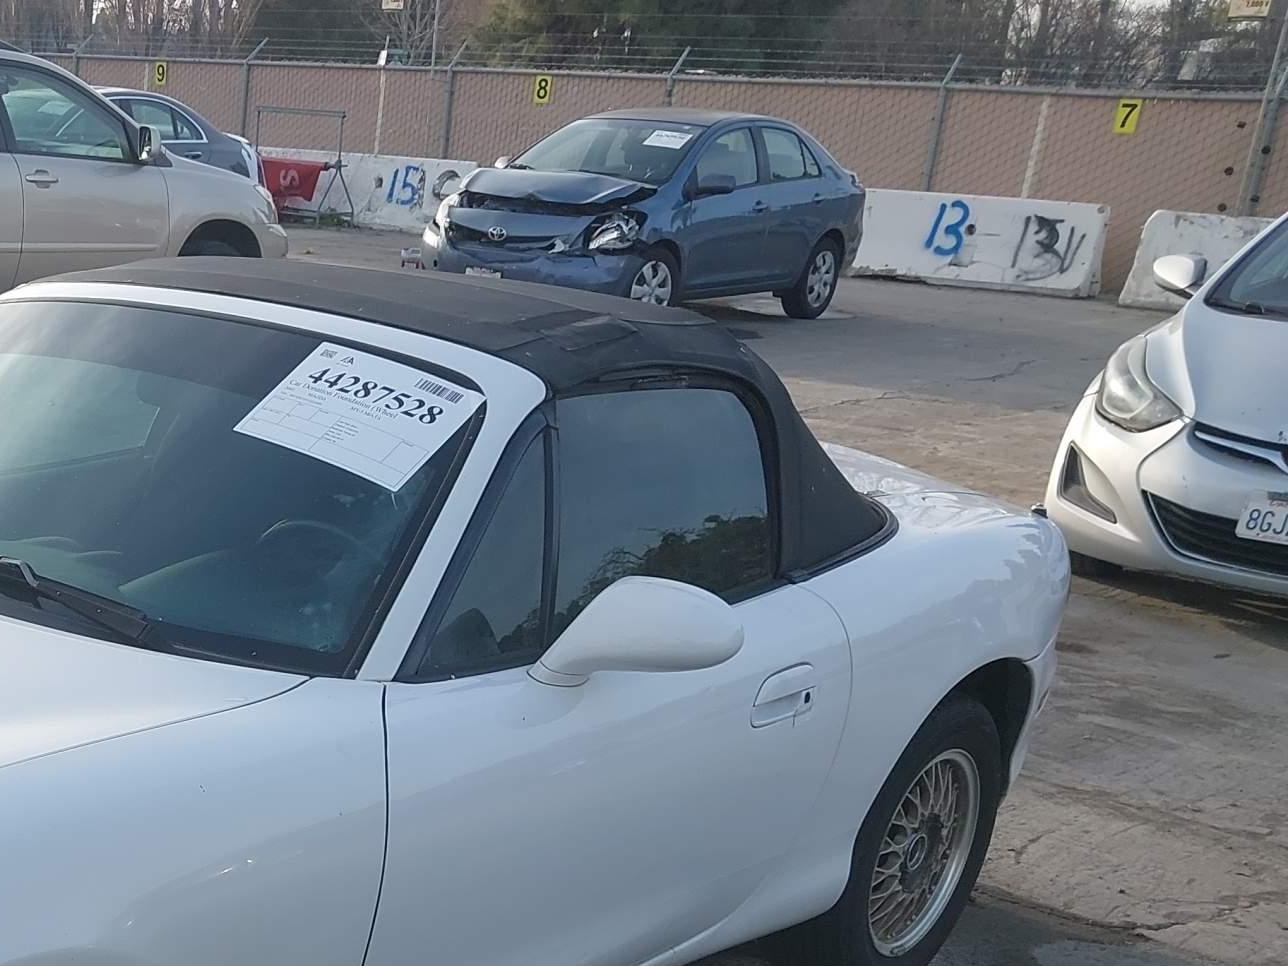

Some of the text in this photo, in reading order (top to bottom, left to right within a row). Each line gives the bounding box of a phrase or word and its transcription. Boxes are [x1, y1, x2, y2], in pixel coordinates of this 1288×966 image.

[156, 64, 166, 84] 9
[537, 77, 548, 100] 8
[1120, 103, 1138, 128] 7
[924, 200, 970, 256] 13
[308, 367, 444, 425] 44287528
[1246, 508, 1288, 537] 8GJ
